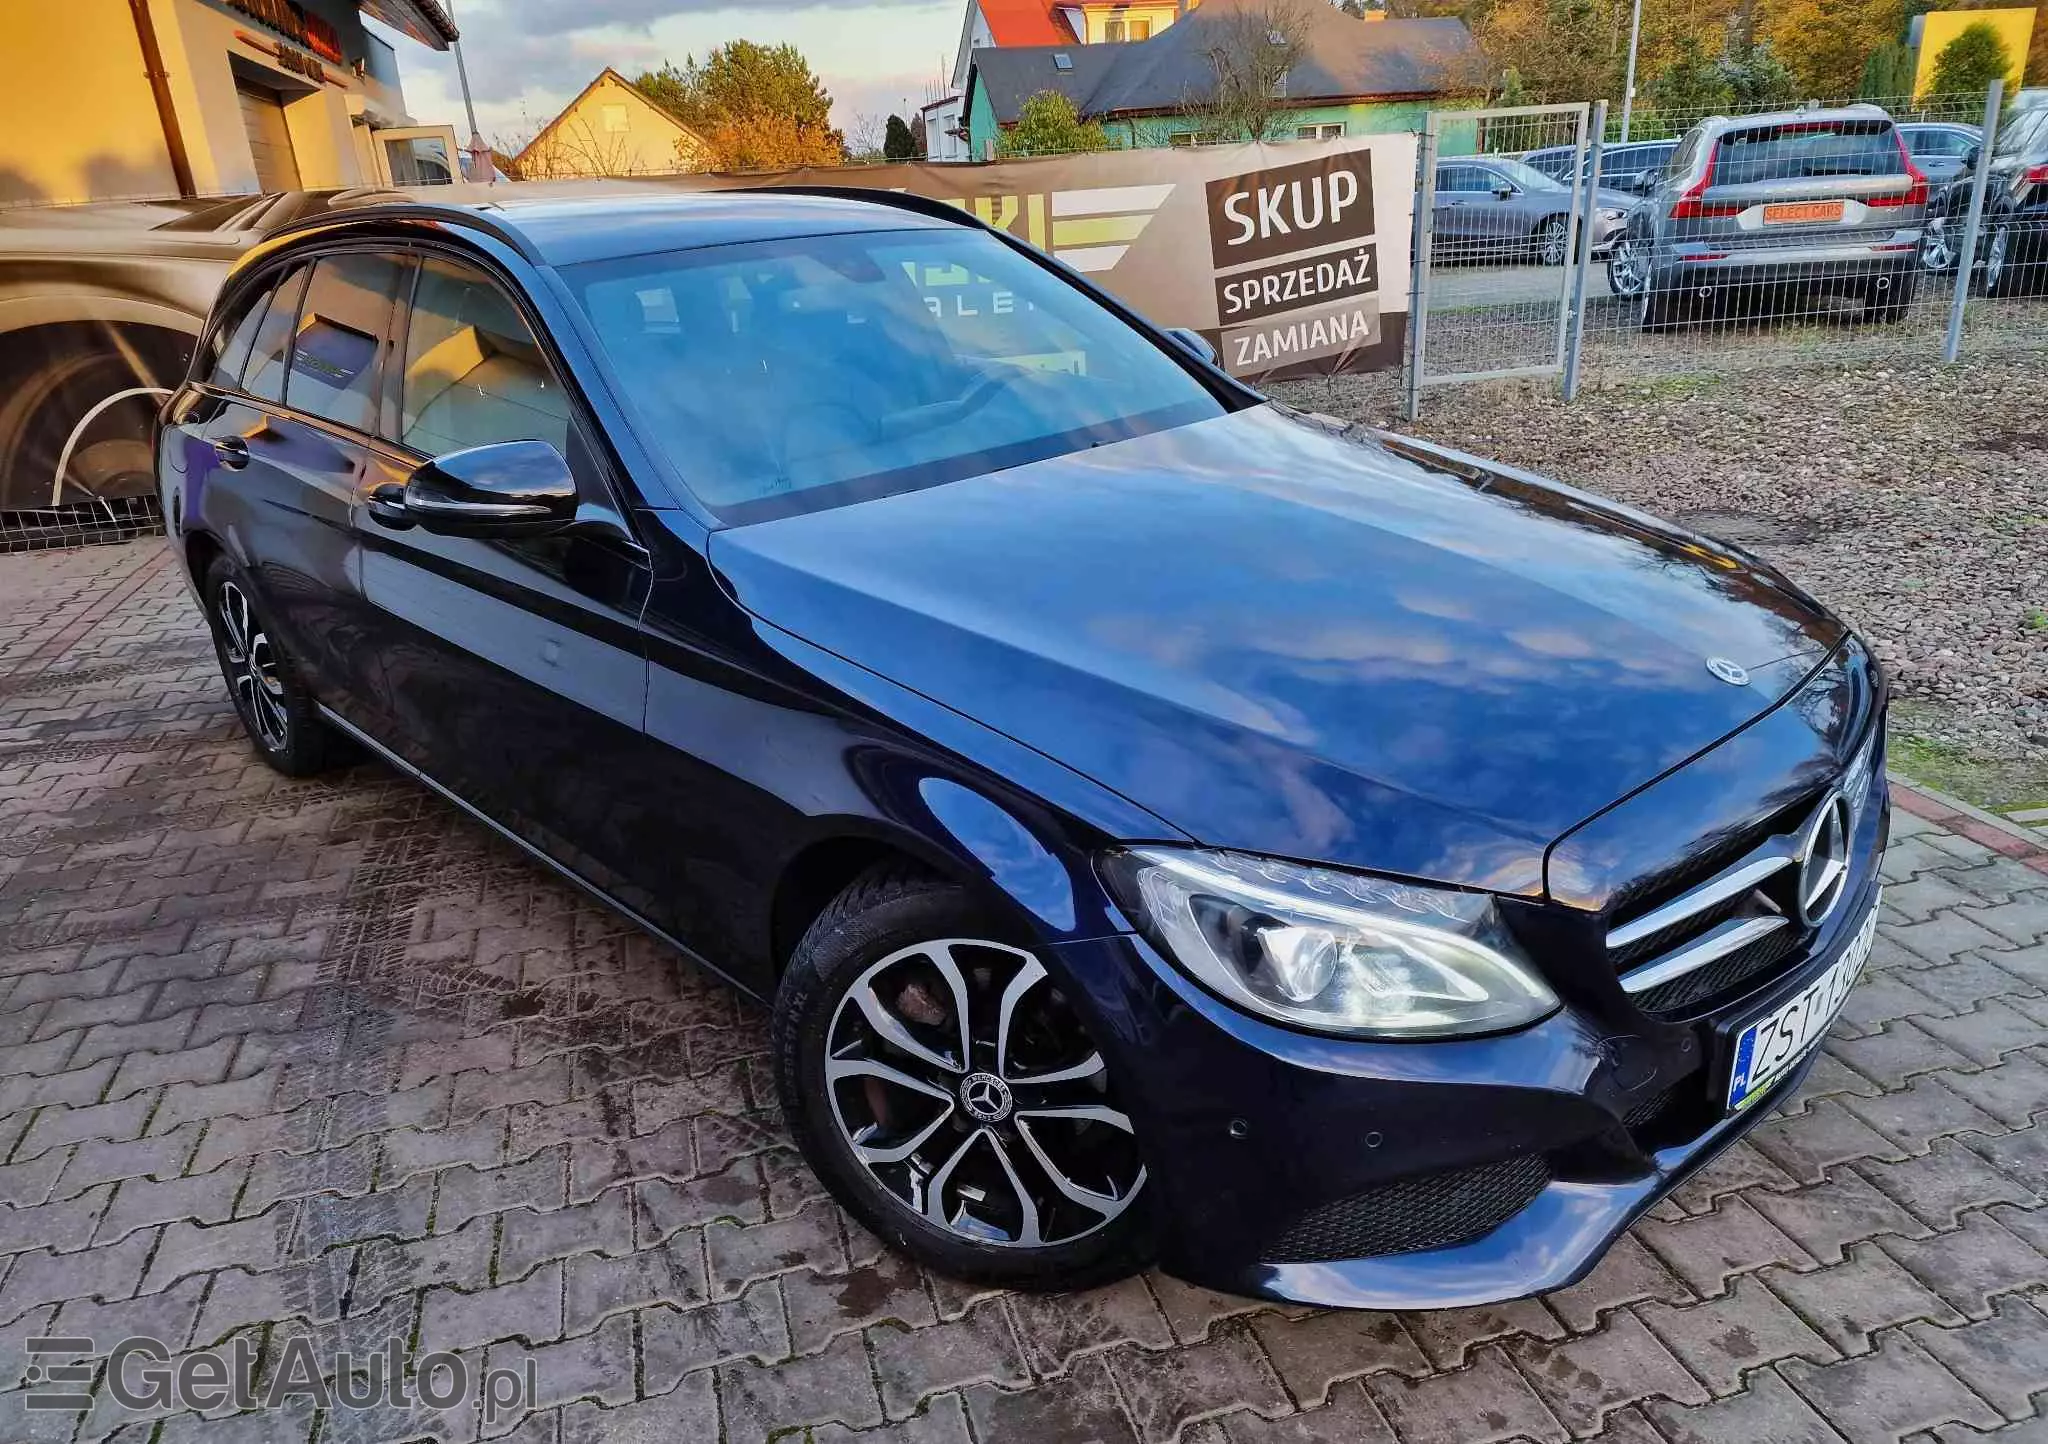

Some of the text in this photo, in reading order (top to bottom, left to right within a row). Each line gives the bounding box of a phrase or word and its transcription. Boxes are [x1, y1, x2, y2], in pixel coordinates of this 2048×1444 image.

[1224, 169, 1358, 247] SKUP
[1767, 203, 1842, 219] SELECT CARS
[1223, 249, 1371, 315] SPRZEDAŻ
[1234, 310, 1369, 367] ZAMIANA
[1752, 986, 1819, 1081] ZST
[1733, 1073, 1745, 1092] PL
